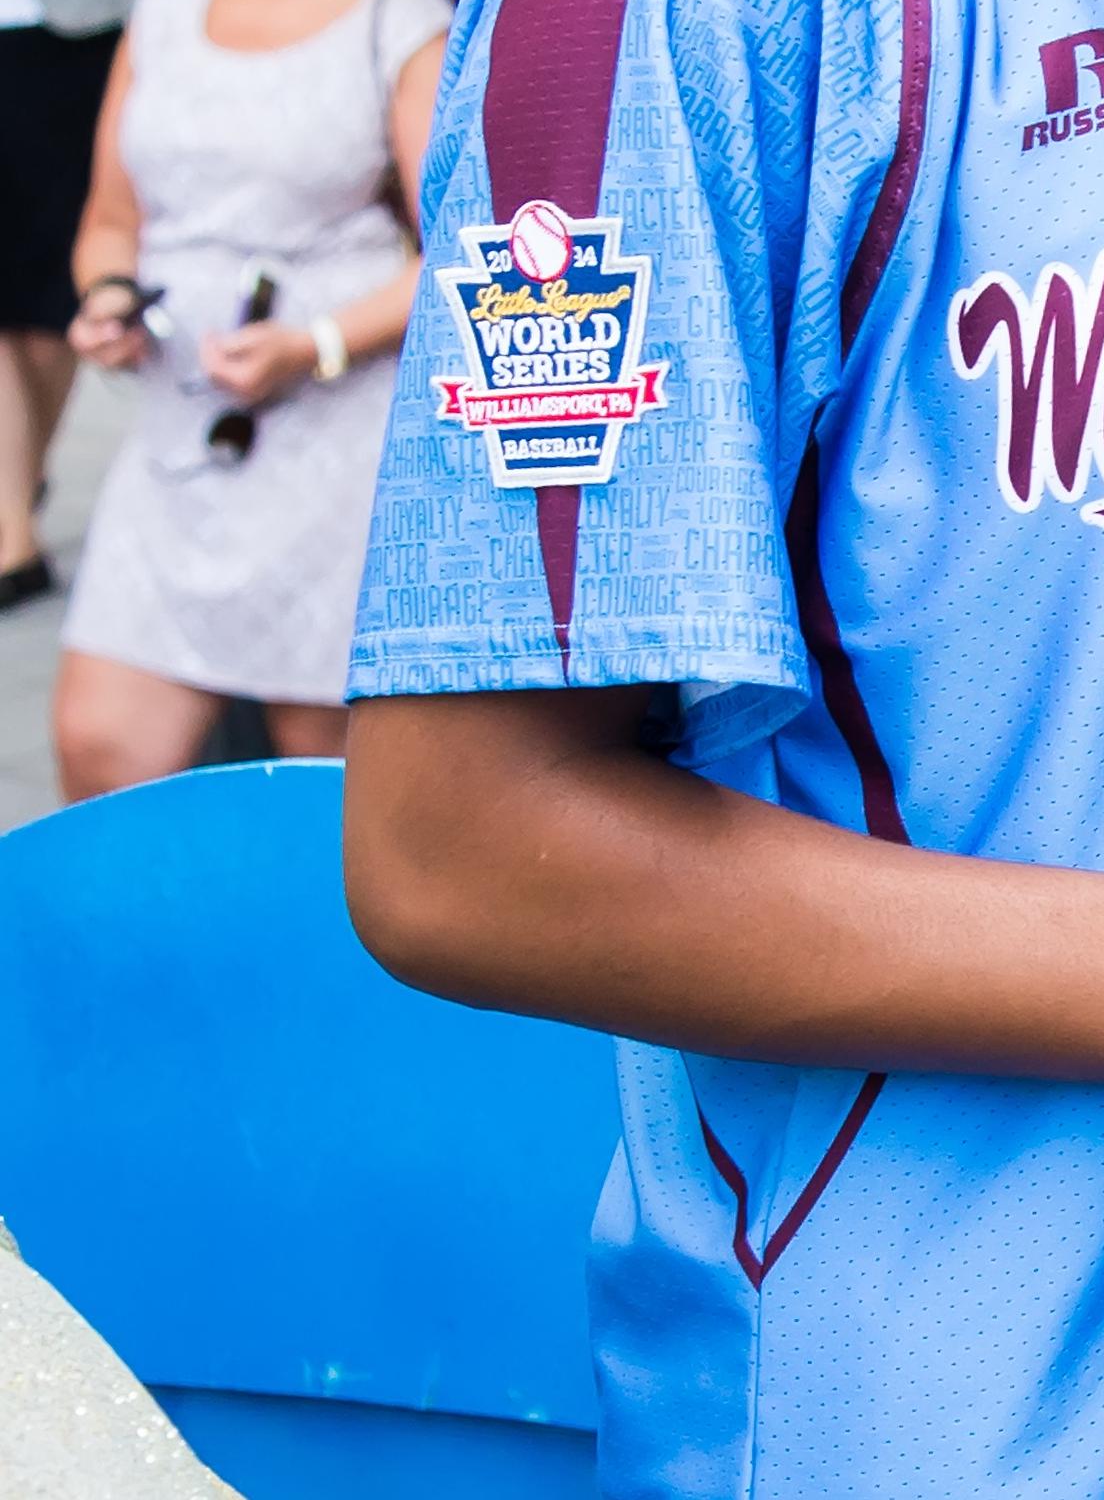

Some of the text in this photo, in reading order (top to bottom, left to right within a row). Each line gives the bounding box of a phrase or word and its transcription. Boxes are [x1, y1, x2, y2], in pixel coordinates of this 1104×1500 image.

[486, 250, 512, 273] 20
[471, 278, 632, 323] Little League
[475, 312, 621, 357] WORLD
[491, 350, 611, 388] SERIES
[608, 393, 633, 414] PA
[502, 435, 601, 461] BASEBALL
[387, 573, 685, 628] COURAGE COURAGE
